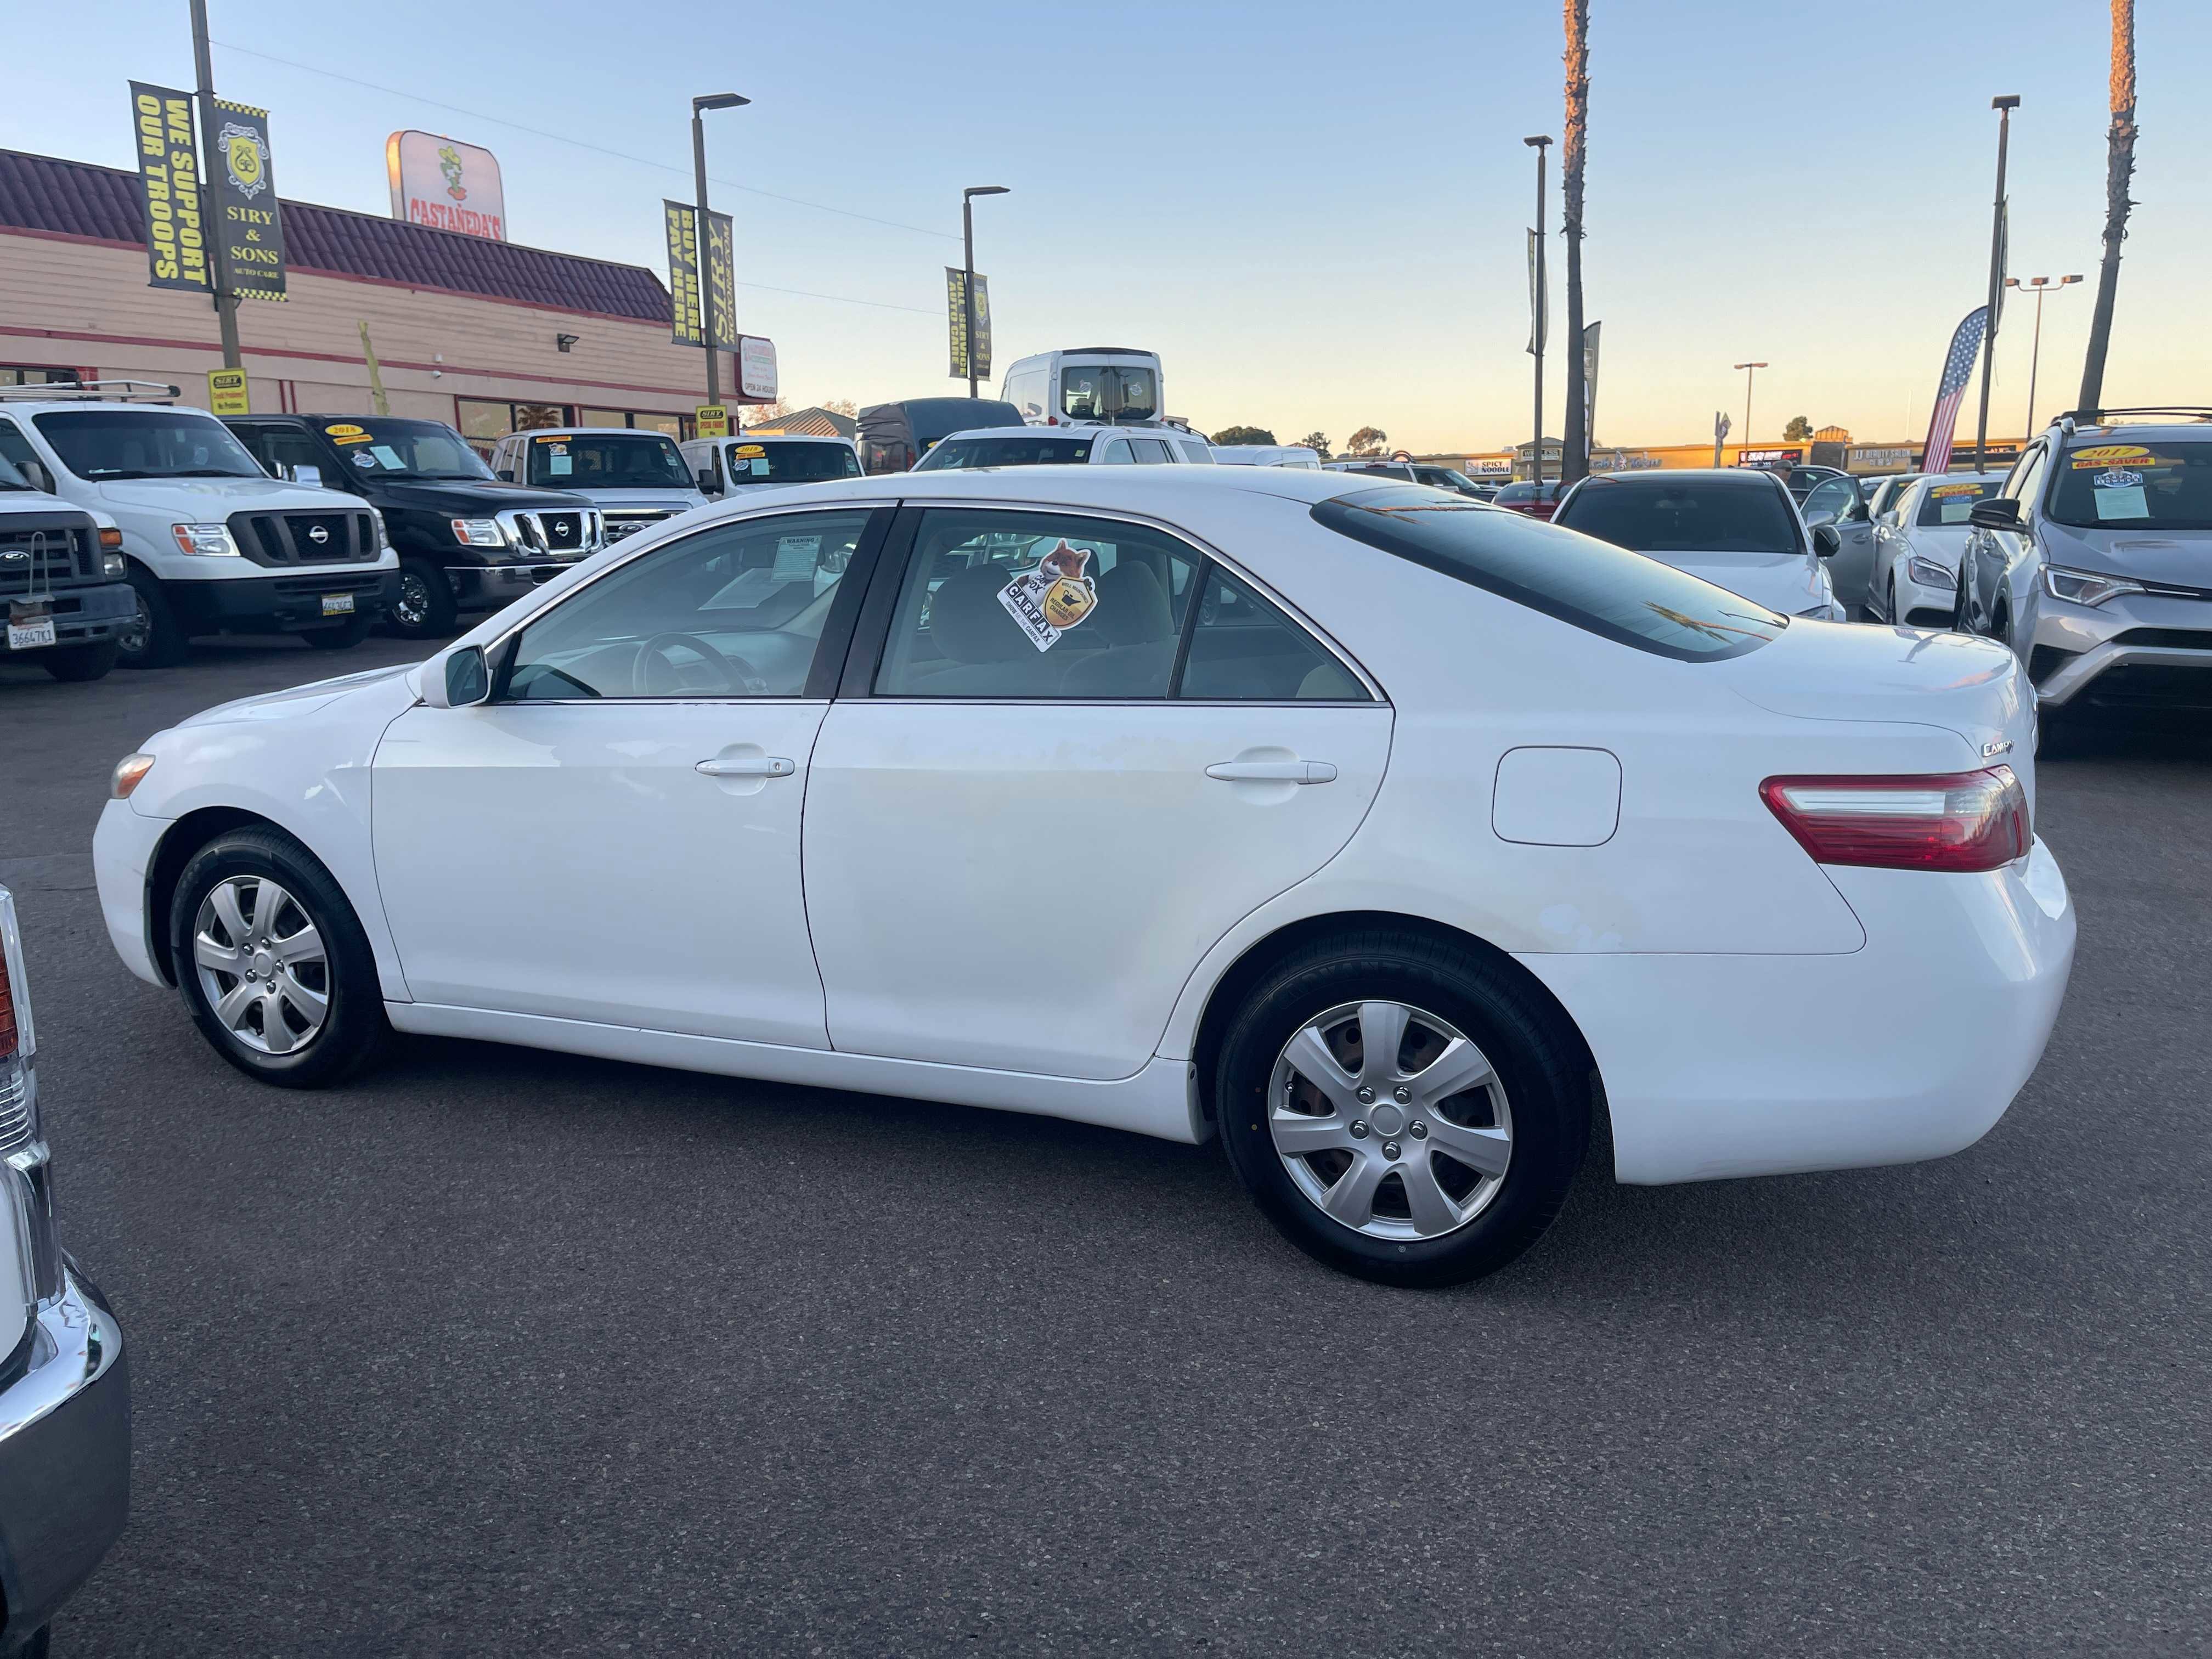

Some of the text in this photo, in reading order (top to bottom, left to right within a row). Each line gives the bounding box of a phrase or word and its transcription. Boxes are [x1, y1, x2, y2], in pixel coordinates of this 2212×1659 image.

[137, 94, 179, 279] OUR TROOPS
[166, 99, 207, 285] WE SUPPORT
[227, 206, 274, 225] SIRY
[245, 229, 262, 241] &
[230, 245, 279, 264] SONS
[668, 209, 686, 337] PAY HERE
[681, 210, 700, 342] BUY HERE
[708, 217, 728, 344] SIRY
[949, 281, 959, 364] AUTO CARE
[956, 273, 967, 375] FULL SERVICE
[2076, 458, 2151, 467] GAS-SAVER
[2083, 447, 2136, 458] 2017
[1006, 601, 1017, 614] SHOW
[1019, 618, 1028, 627] THE
[1025, 625, 1040, 643] CARFAX
[1008, 585, 1053, 641] CARFAX
[1050, 597, 1068, 613] REGULAR
[1050, 605, 1068, 620] CHANGES
